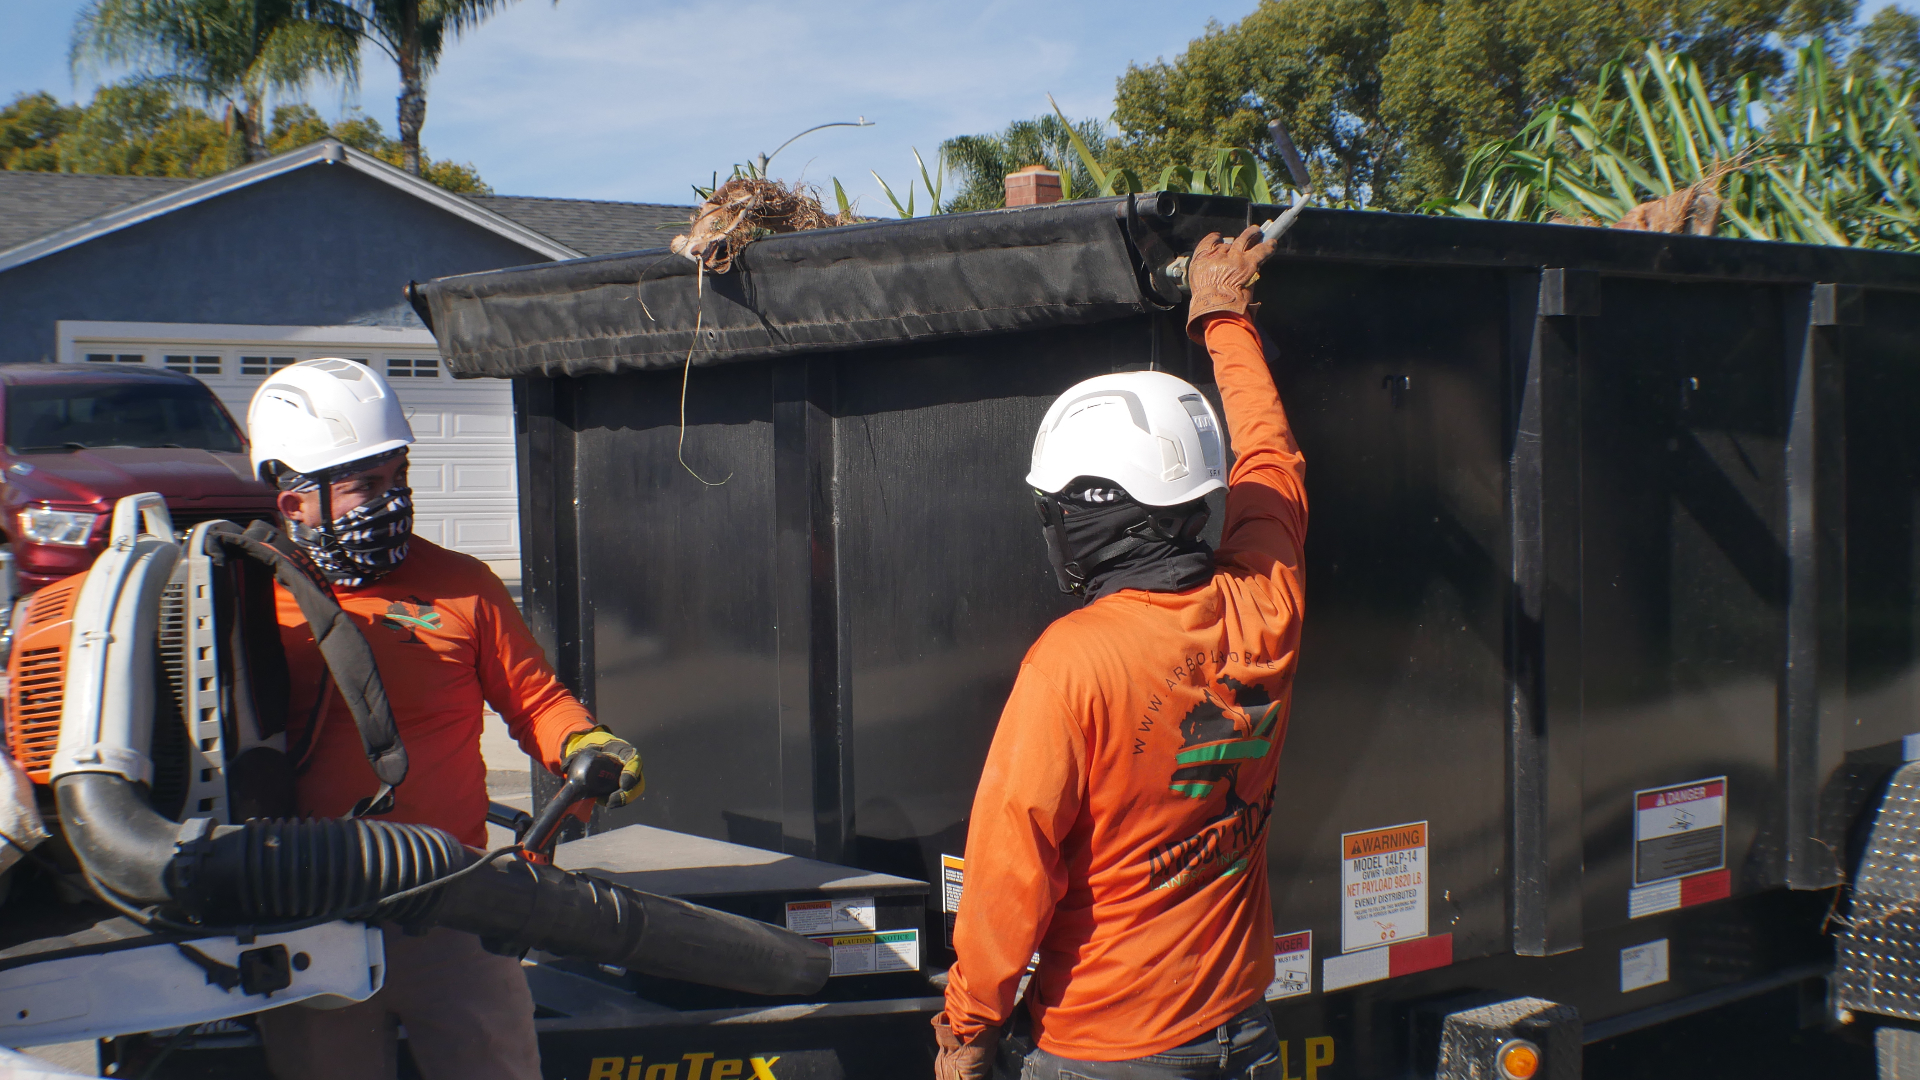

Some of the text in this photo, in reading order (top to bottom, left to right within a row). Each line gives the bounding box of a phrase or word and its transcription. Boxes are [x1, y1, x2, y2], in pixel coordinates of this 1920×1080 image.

[1668, 787, 1706, 805] DANGER
[1362, 830, 1420, 853] WARNING
[1353, 850, 1418, 873] MODEL 14LP-14
[1362, 870, 1381, 880] GVWR
[1346, 883, 1360, 898] NET
[1362, 877, 1392, 895] PAYLOAD
[1412, 871, 1423, 885] LB.
[796, 903, 827, 911] WARNING
[1354, 889, 1417, 908] EVENLY DISTRIBUTED
[842, 937, 872, 945] CAUTION
[882, 933, 910, 941] NOTICE
[1275, 937, 1303, 953] NGER
